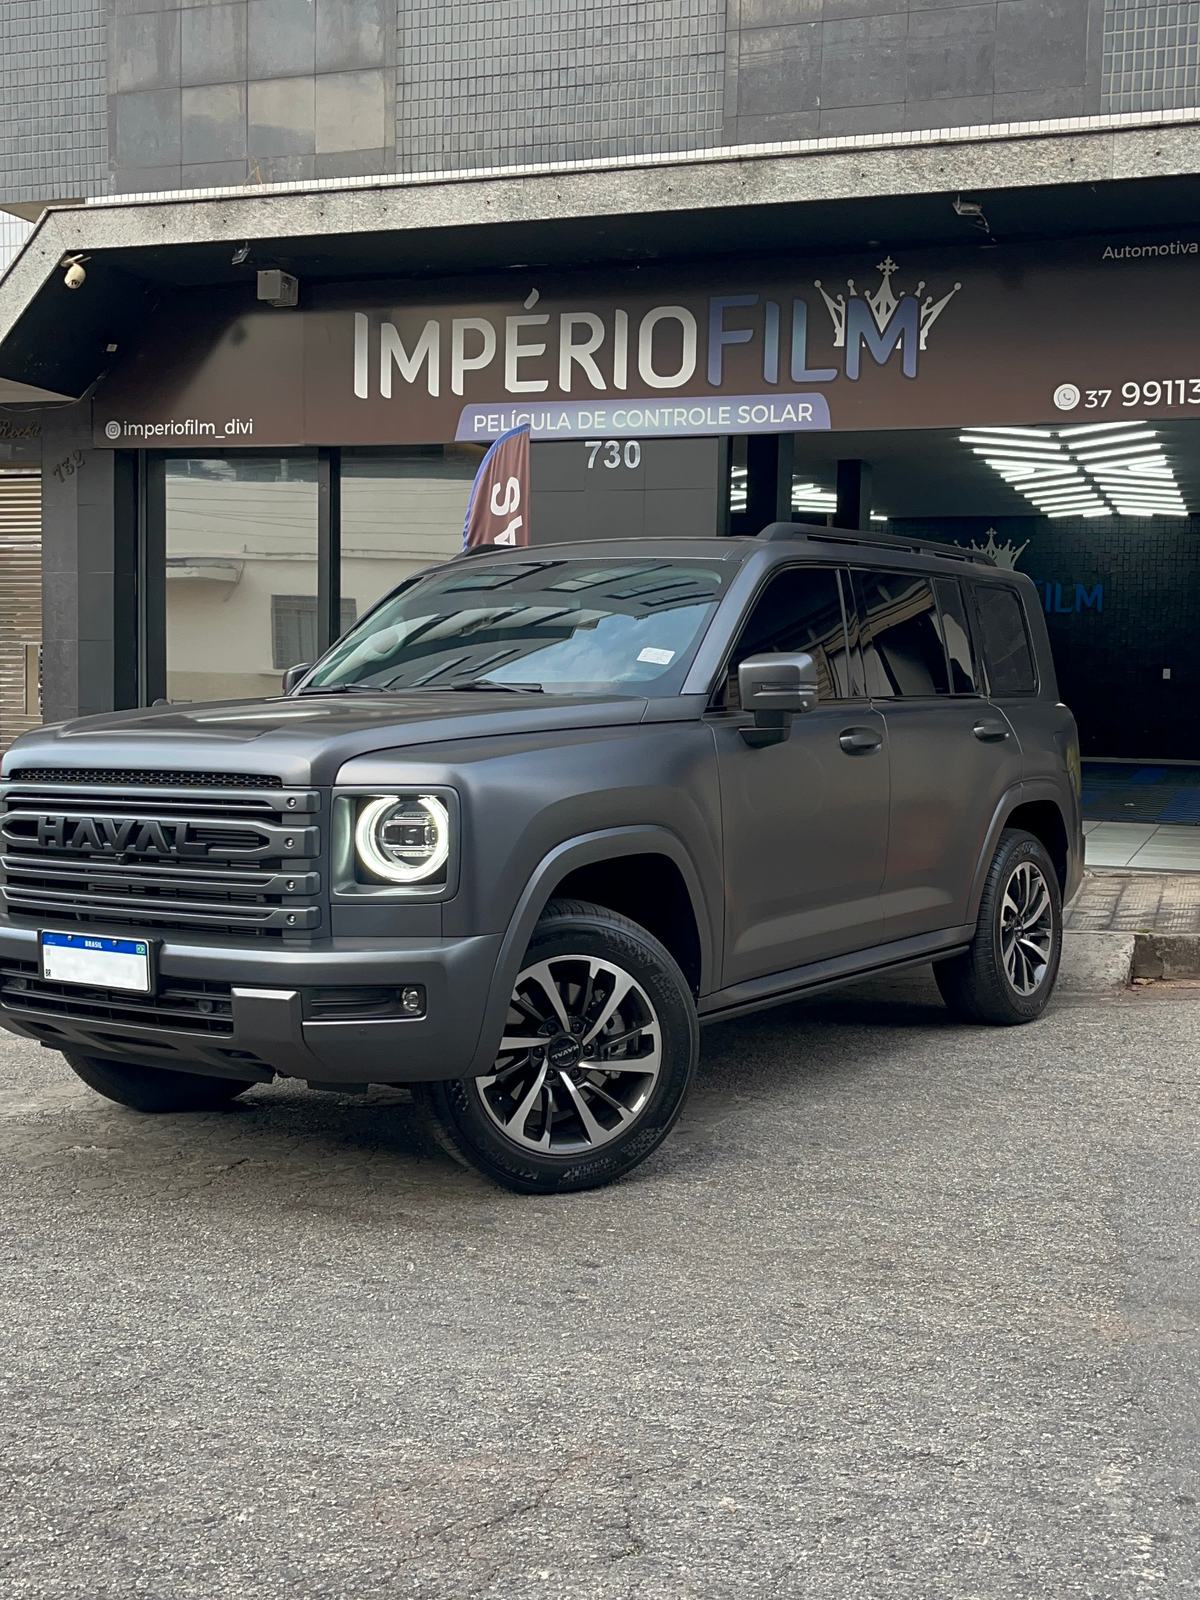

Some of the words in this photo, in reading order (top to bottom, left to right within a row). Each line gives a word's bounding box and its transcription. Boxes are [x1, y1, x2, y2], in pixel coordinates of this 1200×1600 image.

[1102, 240, 1199, 259] Automotiva
[1084, 389, 1112, 408] 37
[578, 411, 606, 429] DE
[612, 406, 731, 428] CONTROLE
[737, 403, 812, 424] SOLAR
[123, 418, 254, 439] imperiofilm_divi
[584, 440, 641, 469] 730
[37, 816, 208, 856] HAVAL
[84, 940, 103, 950] BRASIL
[551, 1043, 580, 1060] HAVAL
